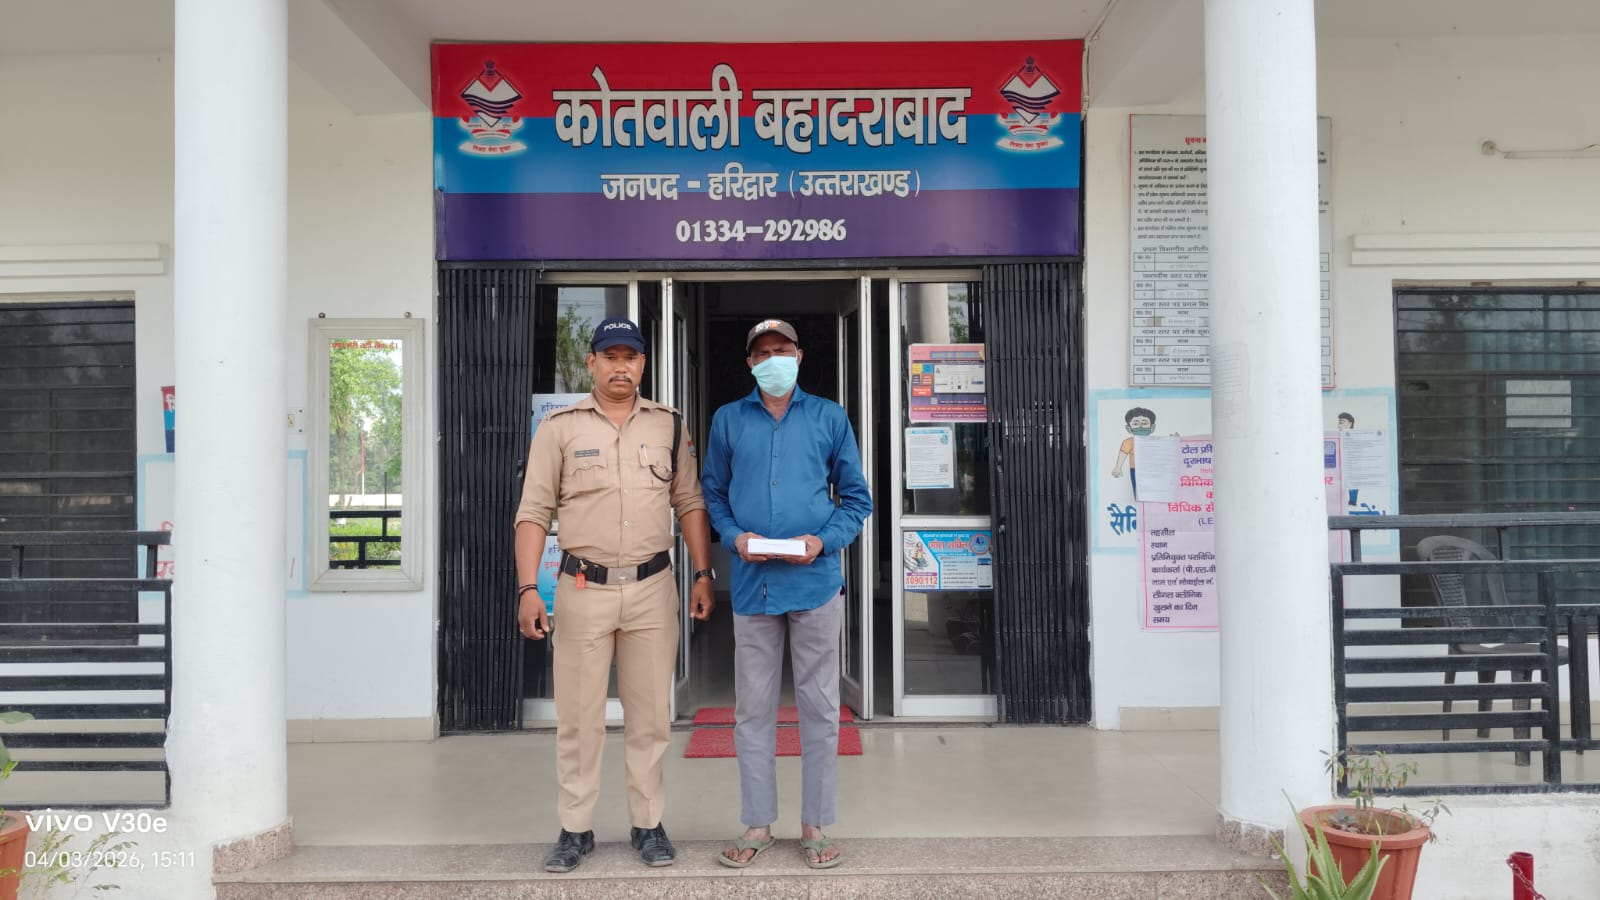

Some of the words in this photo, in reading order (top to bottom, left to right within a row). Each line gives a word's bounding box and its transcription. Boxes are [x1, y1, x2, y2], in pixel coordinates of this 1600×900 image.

[552, 63, 743, 151] कोतवाली
[752, 88, 972, 153] बहादराबाद
[600, 173, 680, 200] जनपद
[707, 161, 780, 201] हरिद्वार
[675, 219, 847, 242] 01334-292986
[604, 322, 632, 332] POLICE
